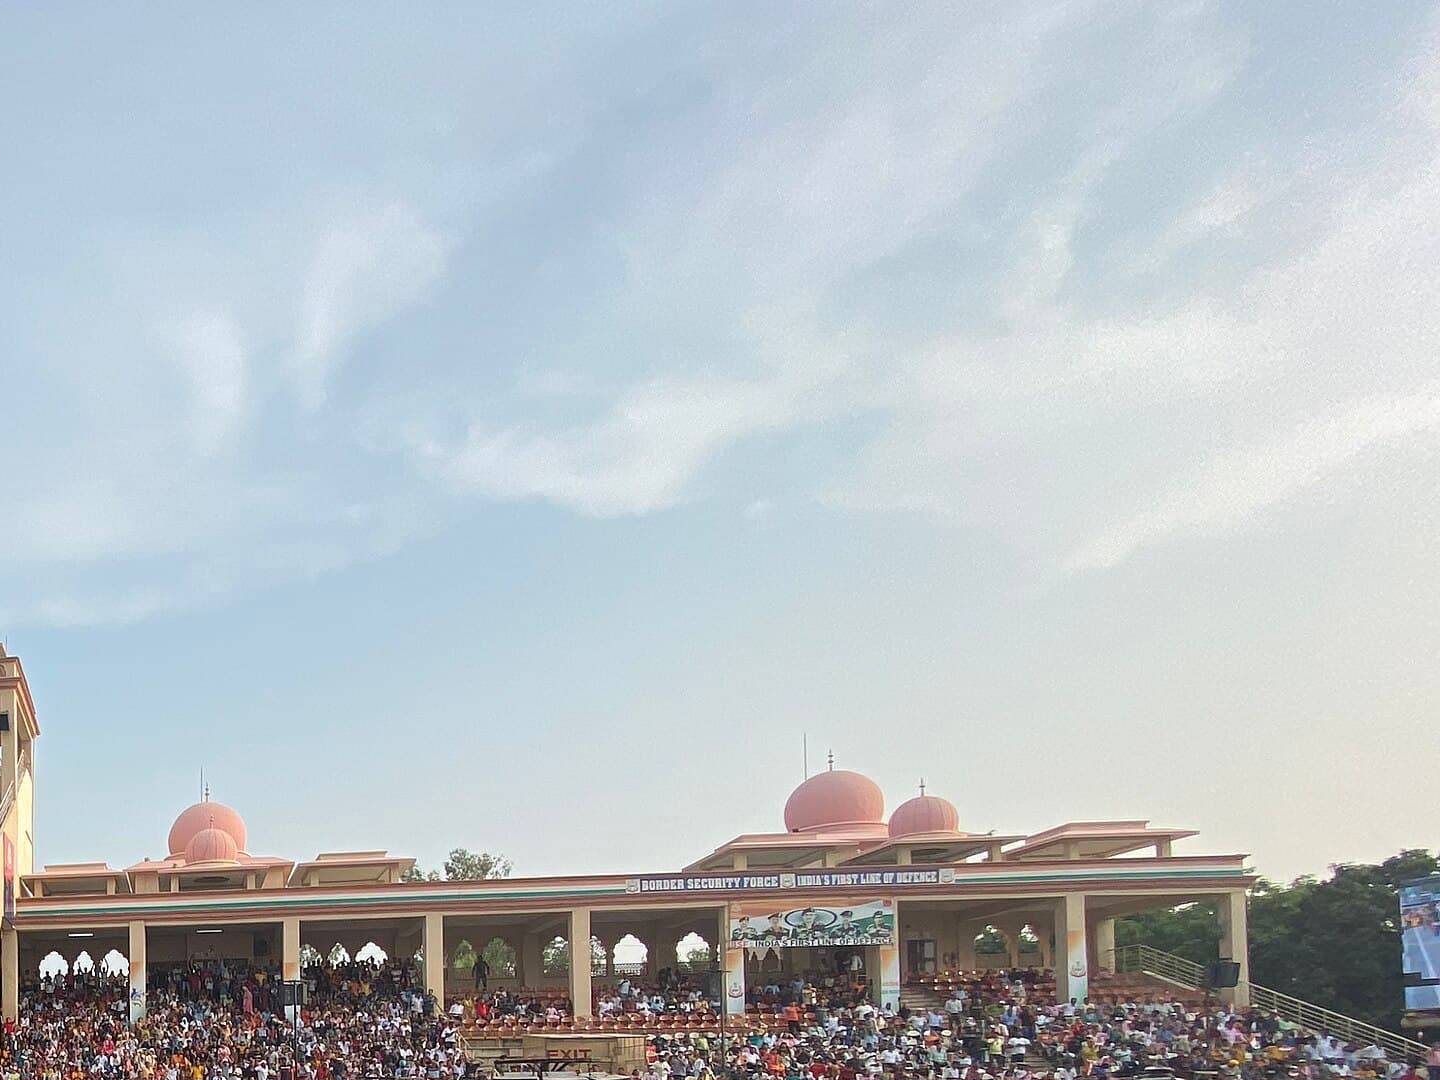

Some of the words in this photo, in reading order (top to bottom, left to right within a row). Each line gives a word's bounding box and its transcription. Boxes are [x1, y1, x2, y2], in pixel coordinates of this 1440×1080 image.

[641, 878, 684, 891] BORDER
[687, 877, 741, 889] SECURITY
[742, 876, 778, 888] FORCE
[797, 874, 830, 886] INDIA'S
[831, 873, 859, 885] FIRST
[860, 873, 881, 884] LINE
[883, 872, 895, 883] OF
[896, 871, 937, 883] DEFENCE
[546, 1049, 592, 1058] EXIT
